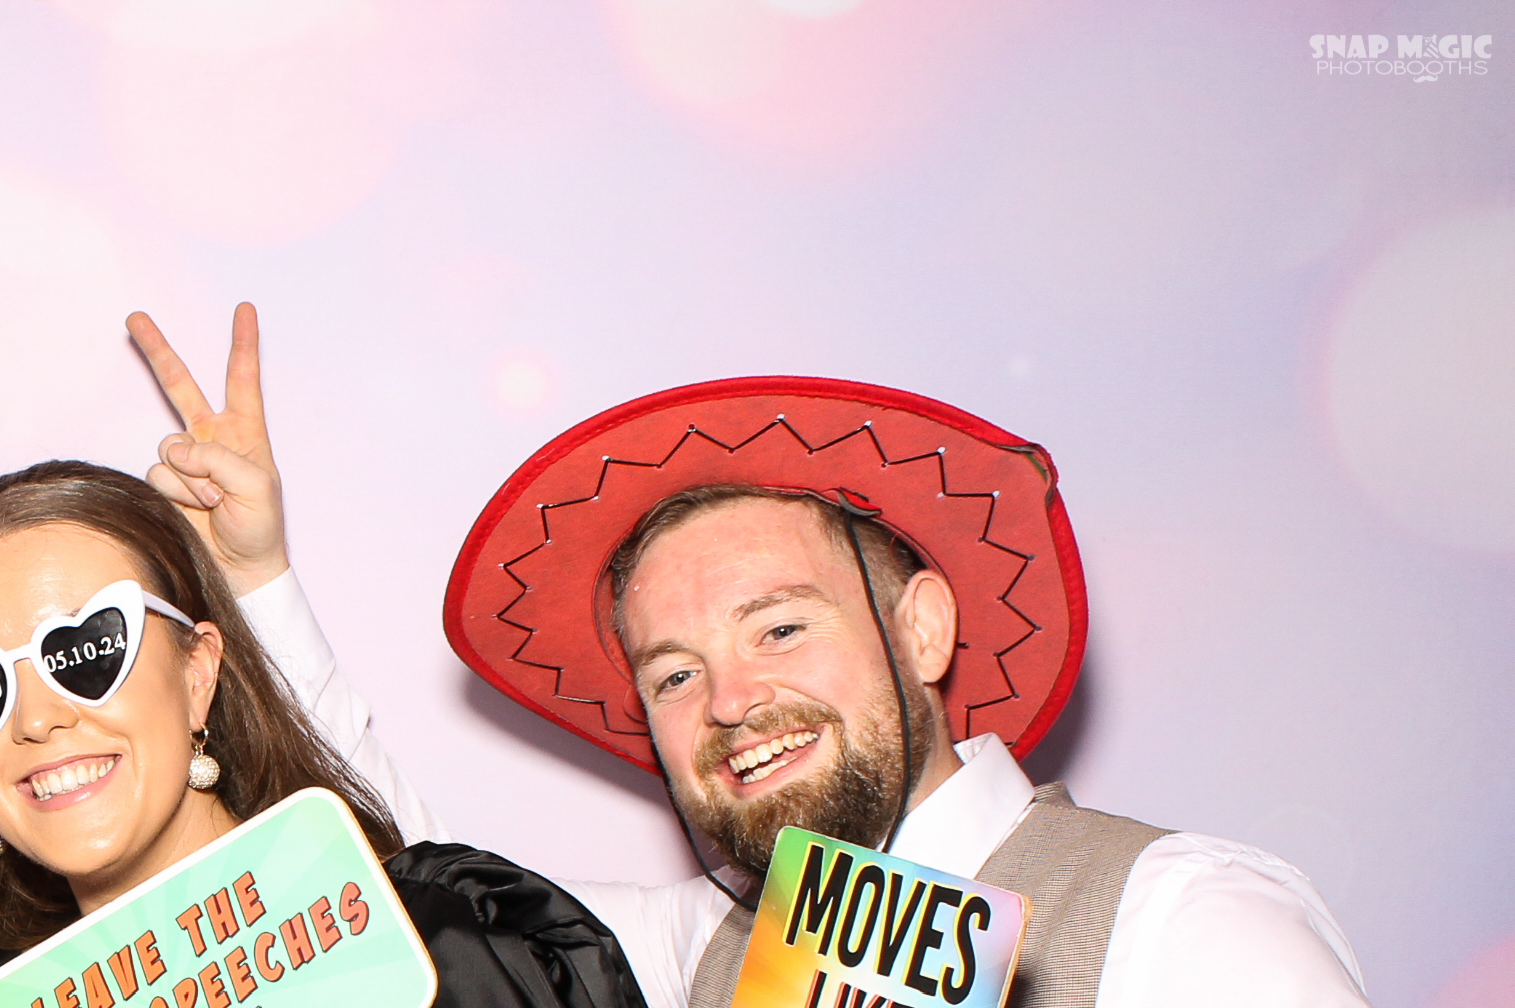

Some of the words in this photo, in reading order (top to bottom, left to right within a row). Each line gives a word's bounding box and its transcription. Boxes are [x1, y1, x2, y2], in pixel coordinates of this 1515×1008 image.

[43, 633, 126, 673] 05.10.24
[175, 870, 266, 957] THE
[782, 841, 991, 1005] MOVES
